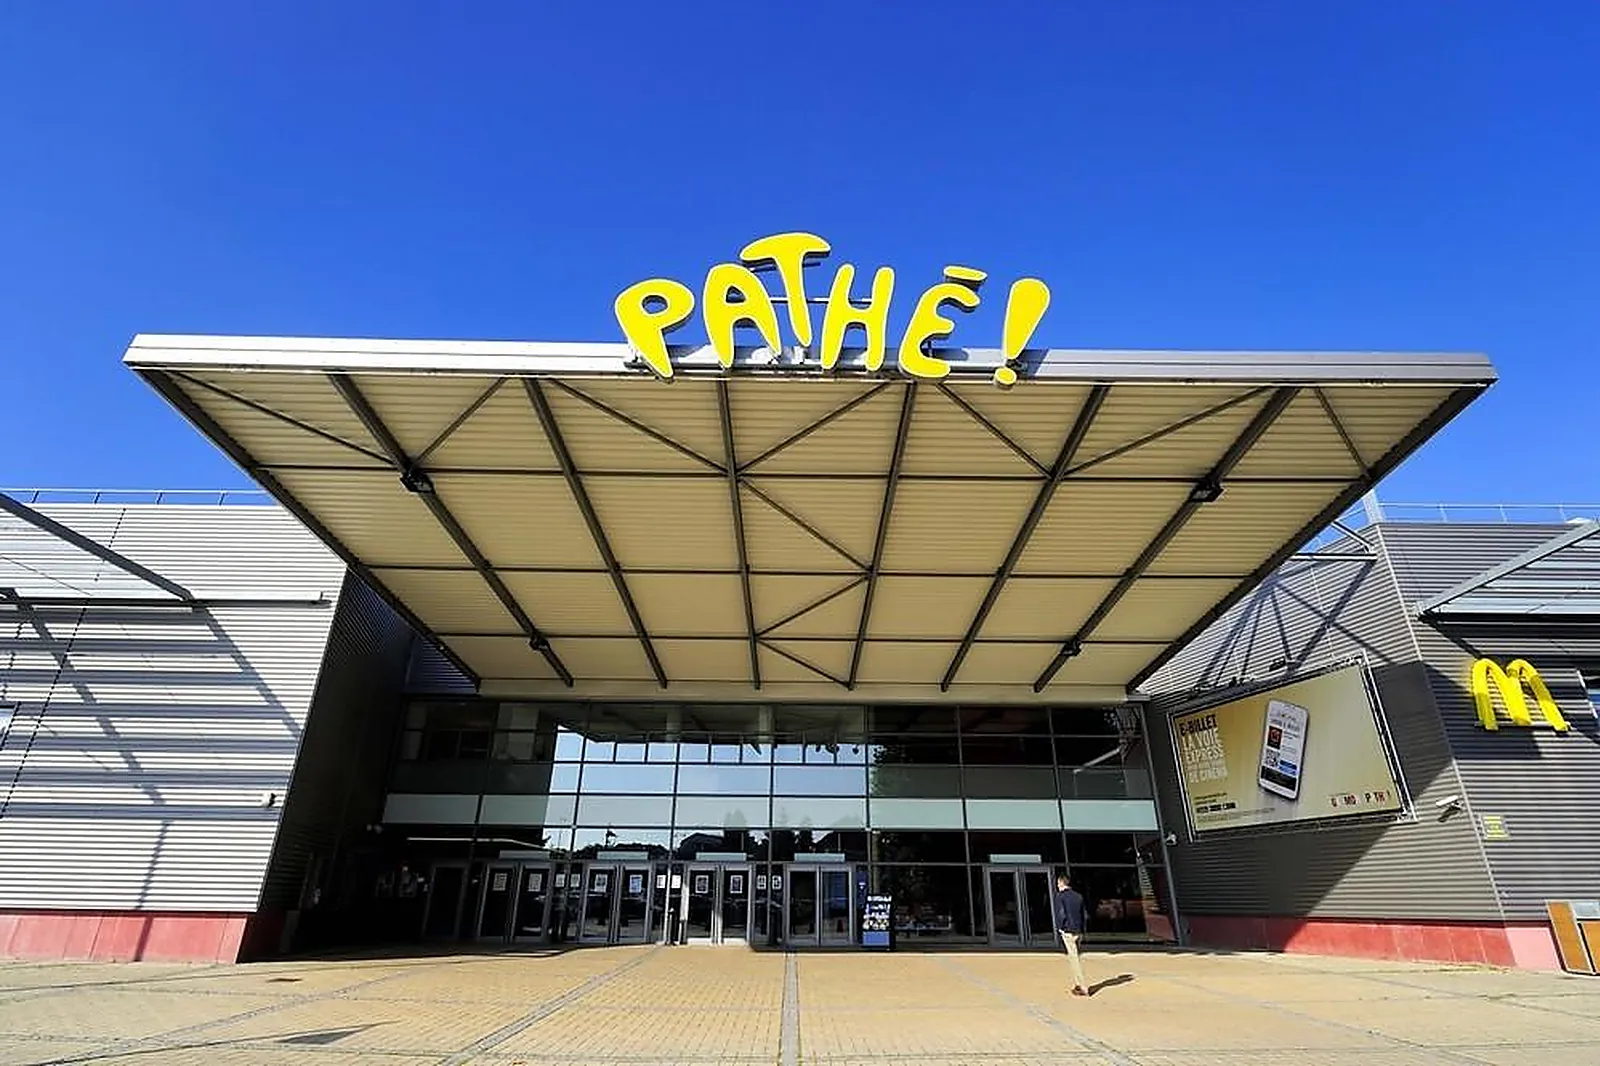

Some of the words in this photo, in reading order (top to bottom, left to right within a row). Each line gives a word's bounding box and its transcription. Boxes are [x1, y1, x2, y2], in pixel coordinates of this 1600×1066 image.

[1179, 714, 1217, 736] E-BILLET
[1194, 727, 1219, 748] VOIE
[1184, 745, 1224, 763] EXPRESS
